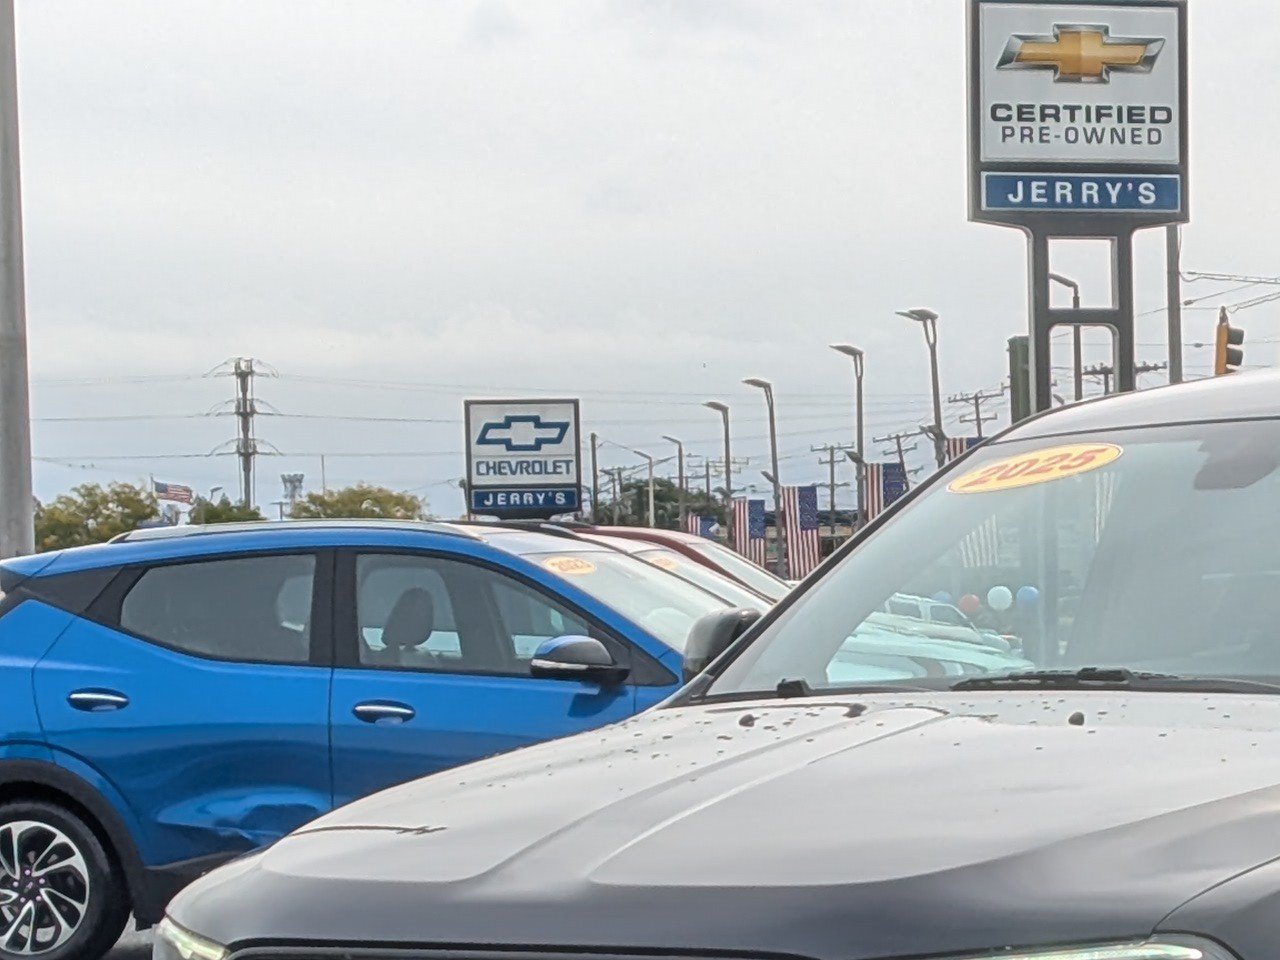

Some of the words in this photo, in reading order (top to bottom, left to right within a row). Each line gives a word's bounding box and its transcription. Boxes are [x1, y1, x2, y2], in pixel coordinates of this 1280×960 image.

[990, 103, 1172, 124] CERTIFIED
[1001, 126, 1163, 145] PRE-OWNED
[1007, 181, 1156, 204] JERRY'S
[476, 459, 573, 476] CHEVROLET
[958, 448, 1109, 488] 2025
[483, 492, 566, 506] JERRY'S
